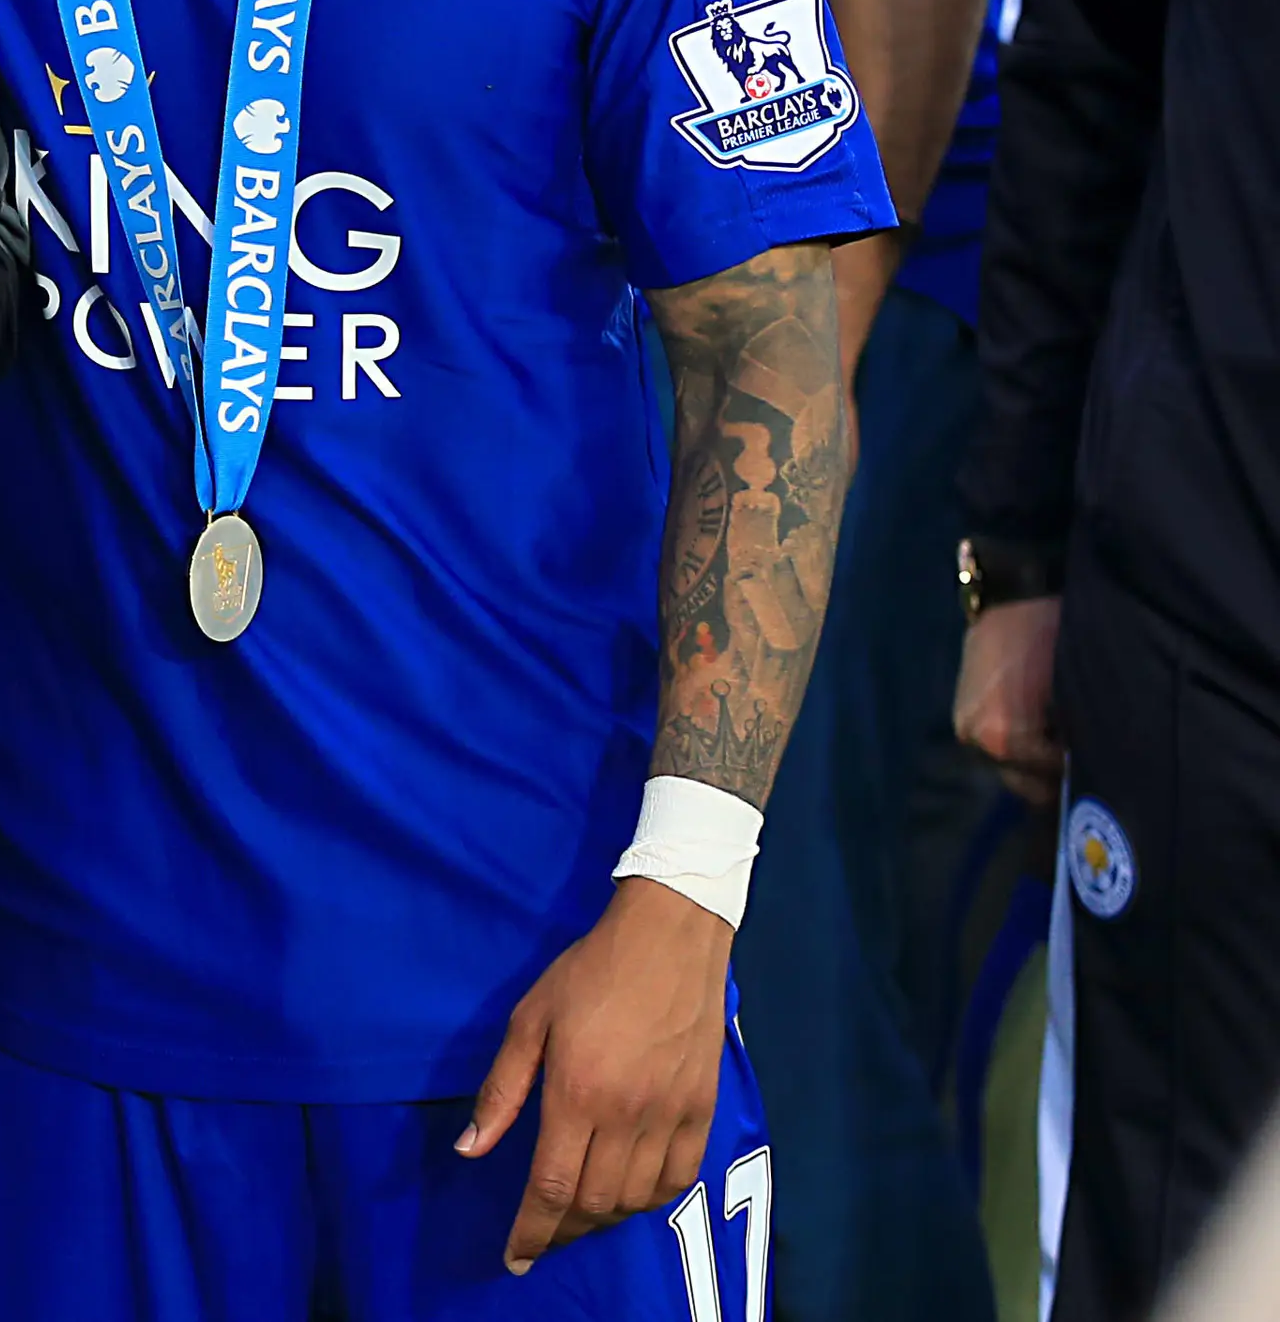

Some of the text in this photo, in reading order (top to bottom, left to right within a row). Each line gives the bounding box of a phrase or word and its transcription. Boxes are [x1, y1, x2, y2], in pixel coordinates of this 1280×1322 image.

[717, 89, 817, 138] BARCLAYS
[722, 108, 821, 151] PREMIER LEAGUE
[13, 128, 401, 291] KIG
[37, 272, 401, 400] OER
[217, 165, 281, 434] BARCLAYS
